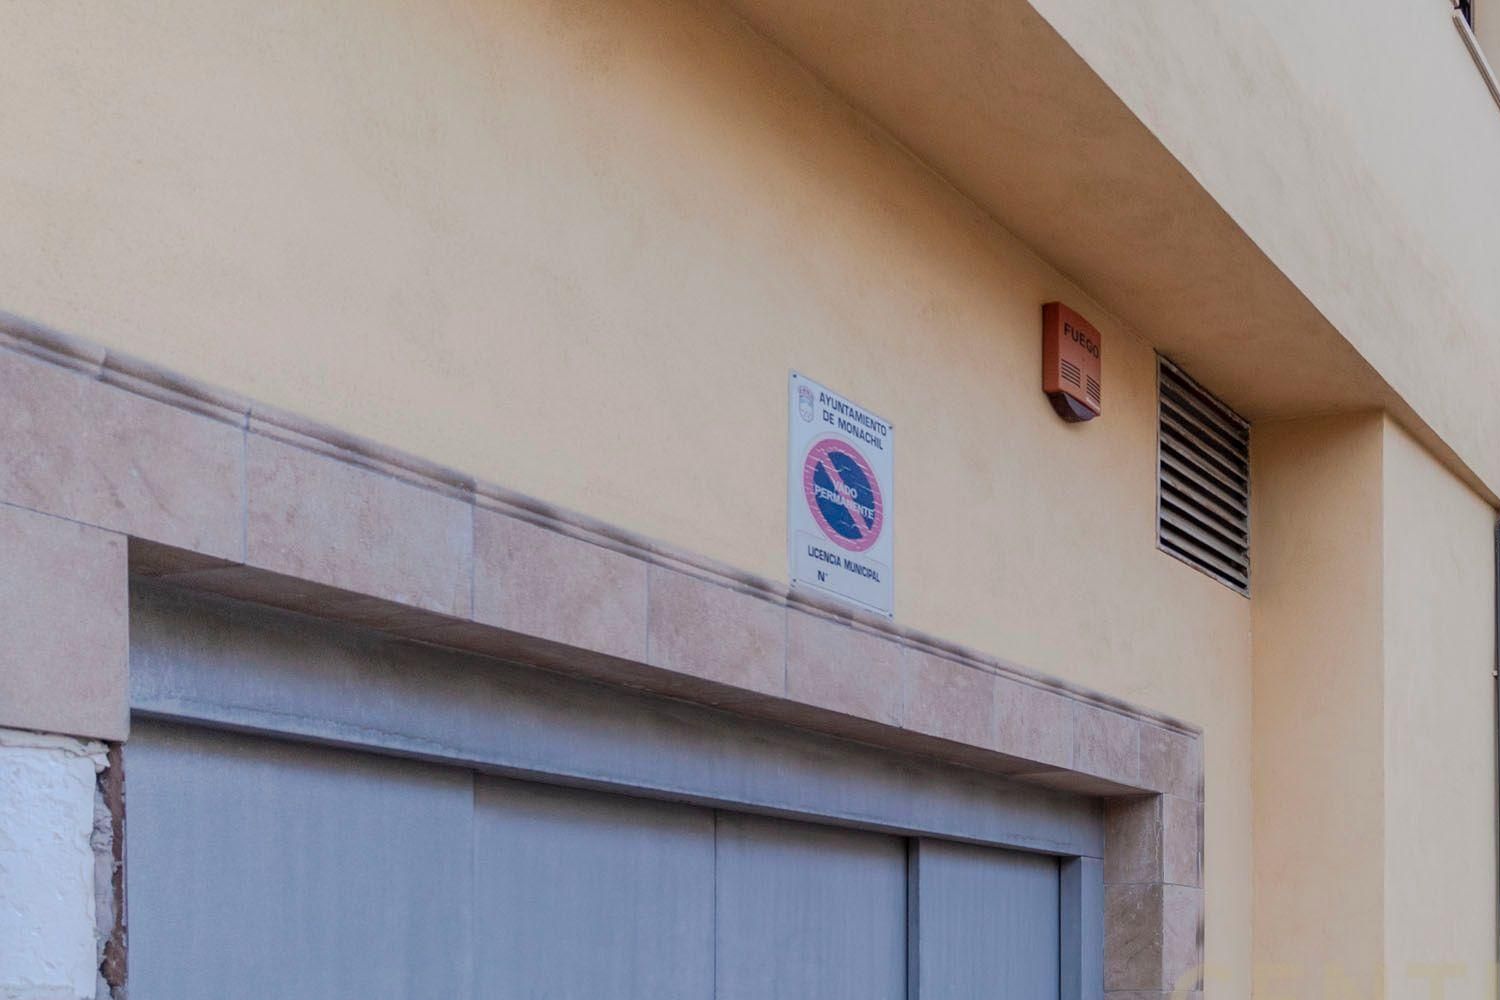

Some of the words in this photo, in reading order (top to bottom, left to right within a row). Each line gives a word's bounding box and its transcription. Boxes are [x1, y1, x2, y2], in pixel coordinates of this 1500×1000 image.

[1064, 321, 1099, 359] FUEGO
[819, 392, 887, 436] AYUNTAMIENTO
[823, 409, 835, 425] DE
[838, 417, 883, 450] MONACHIL
[814, 484, 875, 520] PERMANENTE
[834, 480, 858, 499] VADO
[808, 545, 842, 567] LICENCIA
[844, 557, 881, 583] MUNICIPAL
